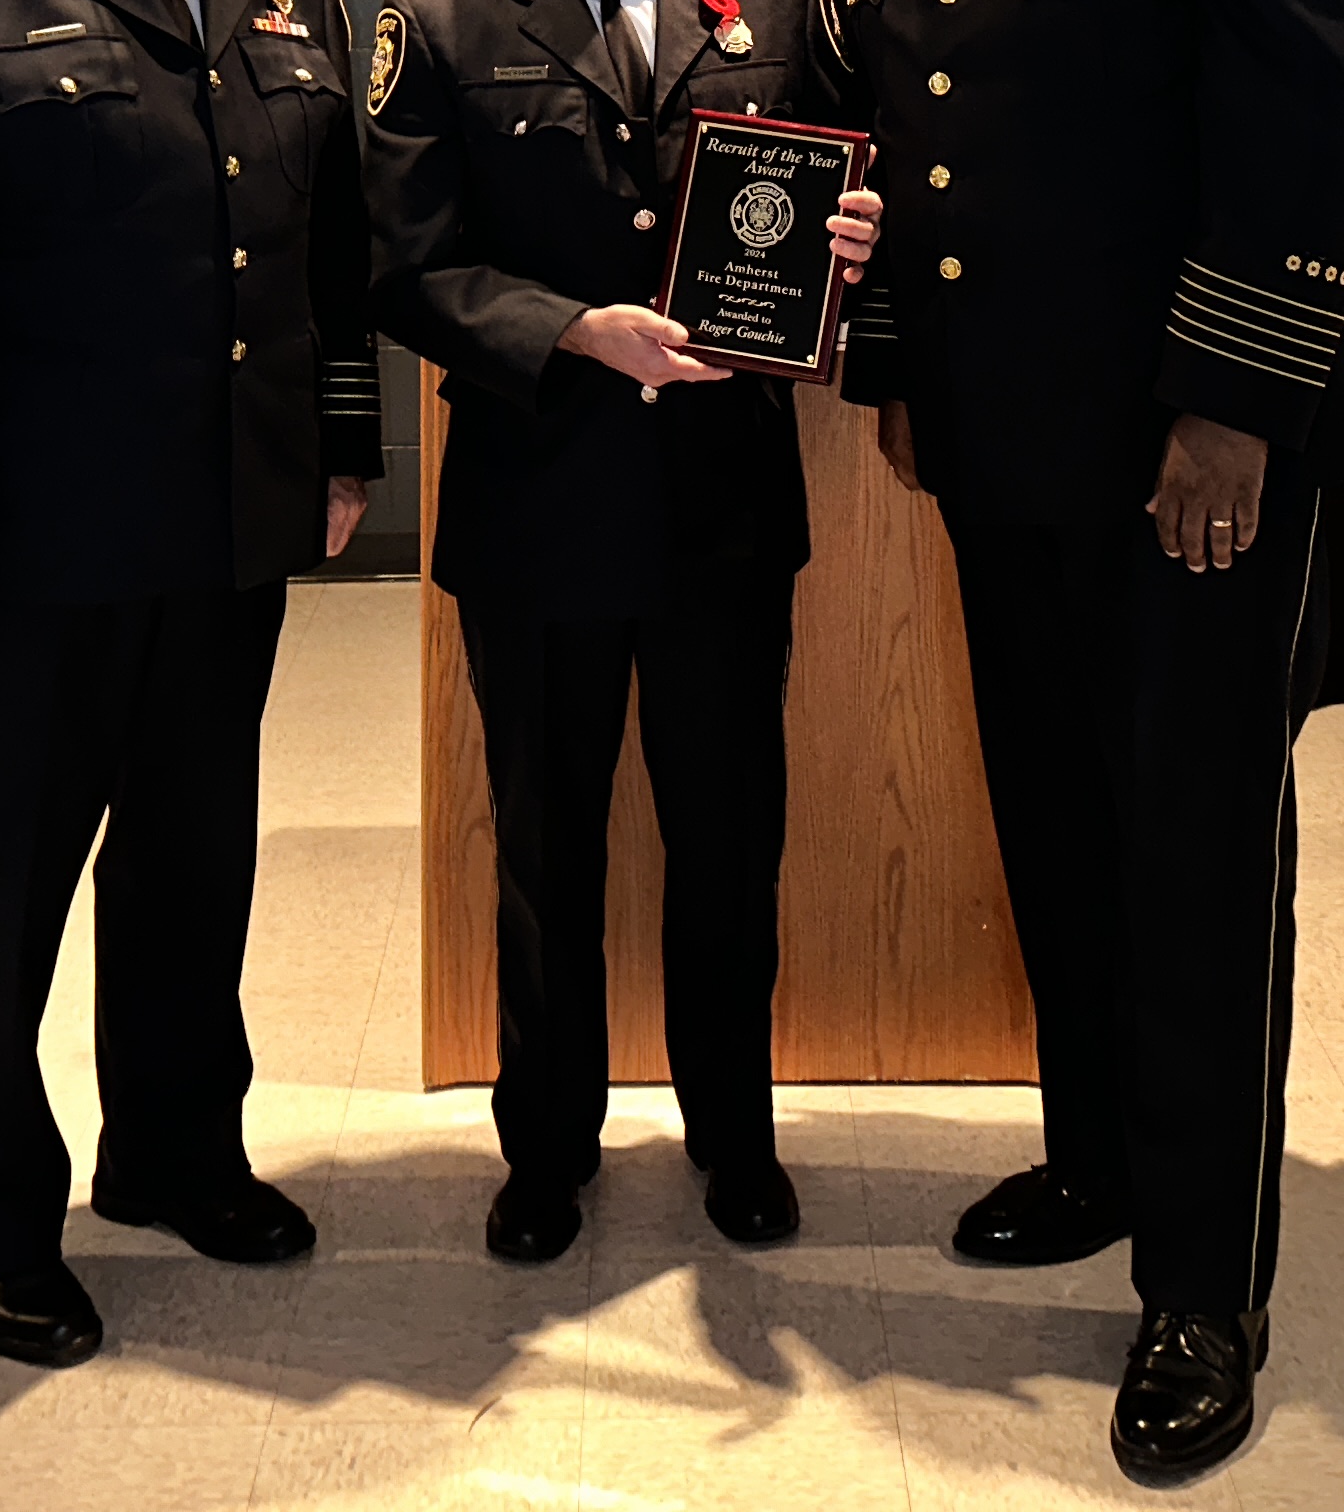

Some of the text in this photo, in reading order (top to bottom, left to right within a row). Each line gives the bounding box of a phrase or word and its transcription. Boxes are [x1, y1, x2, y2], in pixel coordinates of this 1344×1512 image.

[706, 137, 840, 169] Recruit of the Year
[744, 160, 796, 179] Award
[744, 248, 766, 259] 2024
[724, 261, 779, 279] Amherst
[697, 269, 803, 297] Fire Department
[717, 307, 772, 325] Awarded to
[698, 318, 786, 345] Roger Gouchie
